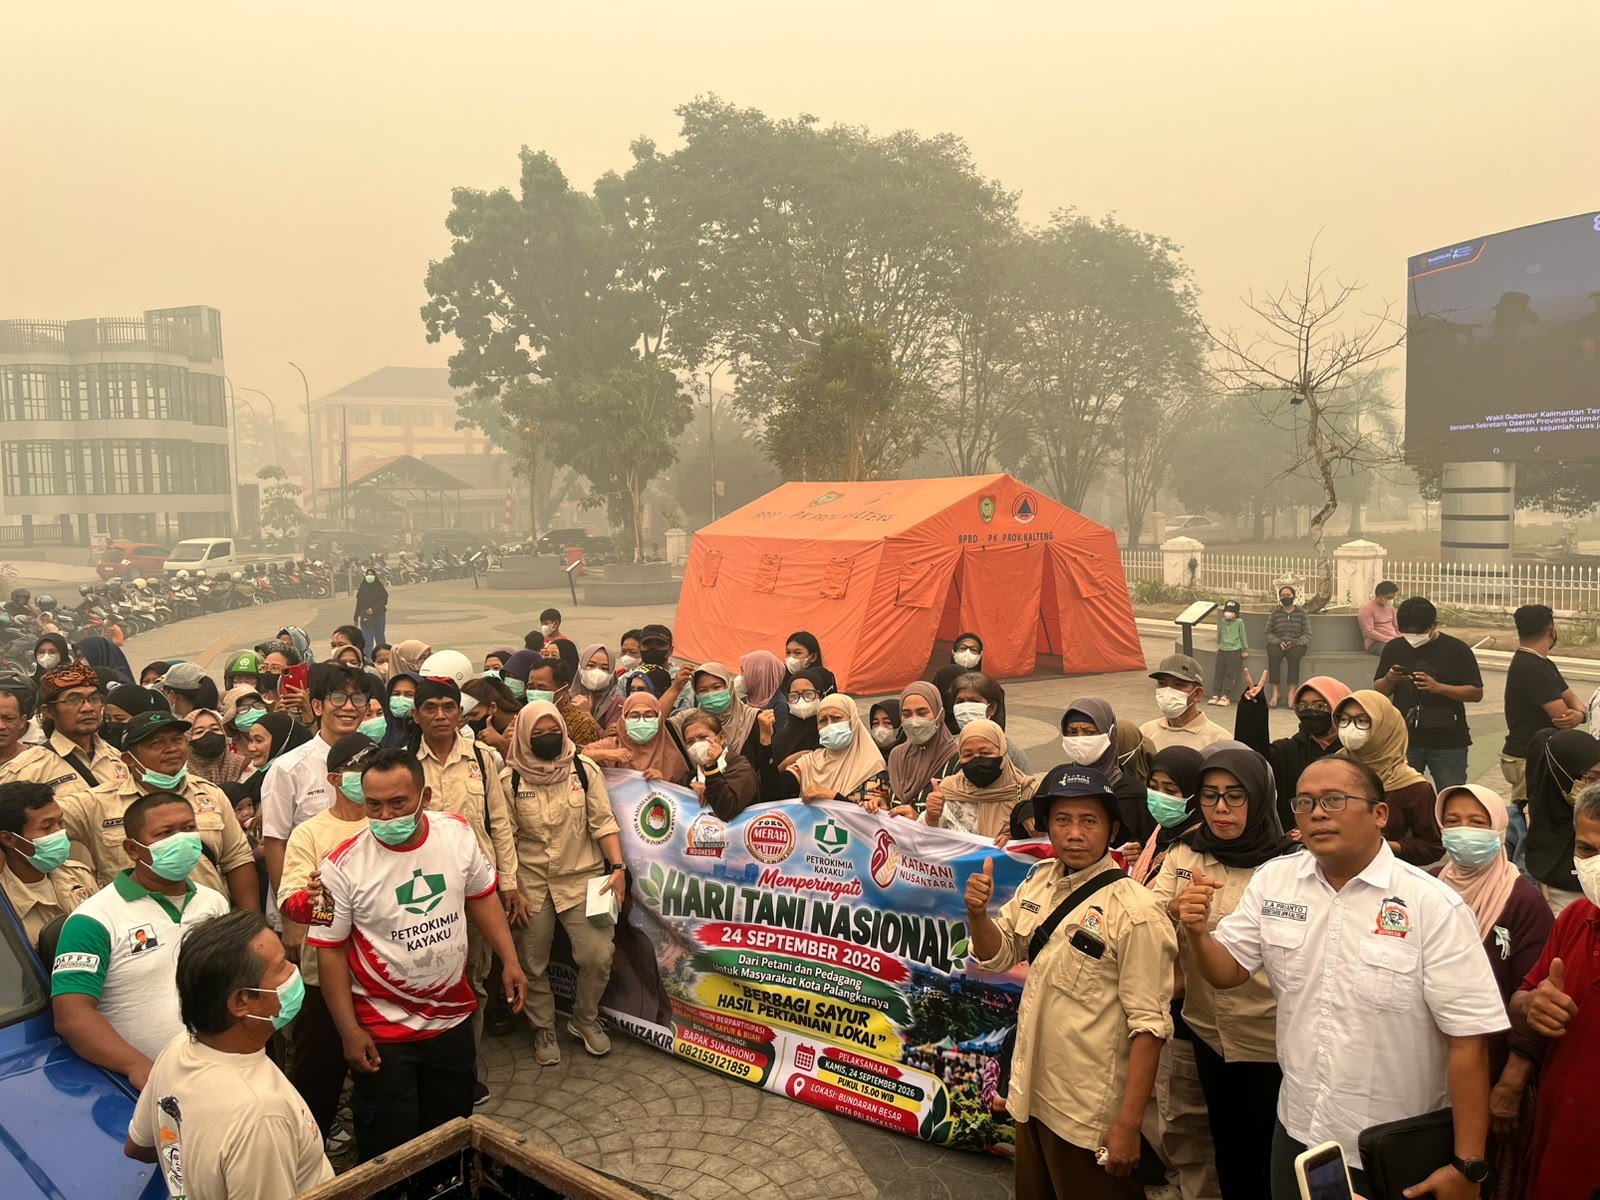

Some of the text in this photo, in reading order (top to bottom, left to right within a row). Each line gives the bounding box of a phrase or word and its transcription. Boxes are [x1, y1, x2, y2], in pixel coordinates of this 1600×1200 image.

[1476, 421, 1508, 429] Sekretaris
[1509, 419, 1535, 427] Daerah
[1536, 417, 1567, 425] Provinsi
[1540, 409, 1584, 418] Kalimantan
[1505, 426, 1538, 434] meninjau
[1540, 423, 1575, 432] sejumlah
[958, 534, 978, 543] BPBD
[988, 533, 998, 542] PK
[753, 828, 787, 842] MERAH
[754, 844, 783, 855] PUTIH
[806, 855, 853, 869] PETROKIMIA
[814, 865, 844, 877] KAYAKU
[899, 870, 955, 889] NUSANTARA
[901, 855, 953, 879] KATATANI
[757, 868, 862, 900] Memperingati
[391, 912, 459, 940] PETROKIMIA
[662, 869, 954, 974] HARI TANI NASIONAL
[407, 928, 451, 951] KAYAKU
[721, 927, 881, 973] 24 SEPTEMBER 2026
[738, 954, 862, 990] Dari Petani dan Pedagang
[713, 963, 889, 1010] Untuk Masyarakat Kota Palangkaraya
[698, 1009, 715, 1021] INGIN
[717, 1015, 765, 1034] BERPARTISIPASI
[717, 994, 754, 1014] HASIL
[757, 1004, 831, 1034] PERTANIAN
[814, 1002, 870, 1028] SAYUR
[620, 1018, 673, 1050] MUZAKIR
[715, 1023, 735, 1035] SAYUR
[743, 1031, 760, 1042] BUAH
[683, 1029, 756, 1062] BAPAK SUKARIONO
[679, 1043, 750, 1076] 082159121859
[838, 1052, 888, 1075] PELAKSANAAN
[825, 1060, 916, 1098] KAMIS, 24 SEPTEMBER 2026
[837, 1077, 895, 1103] PUKUL 15.00 WIB
[810, 1083, 902, 1122] LOKASI: BUNDARAN BESAR
[835, 1104, 852, 1117] KOTA
